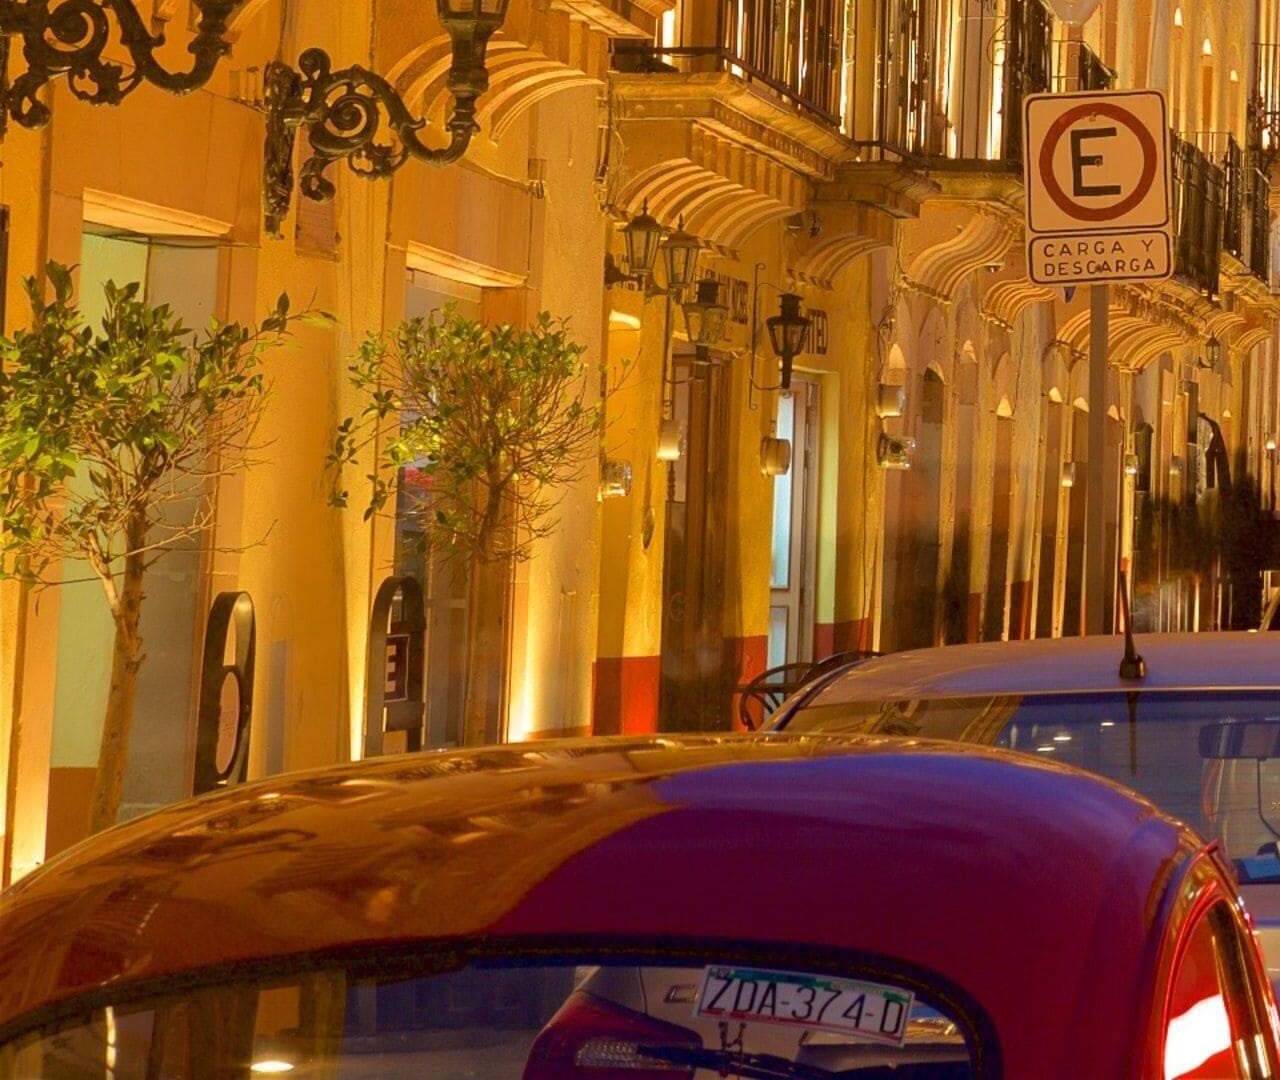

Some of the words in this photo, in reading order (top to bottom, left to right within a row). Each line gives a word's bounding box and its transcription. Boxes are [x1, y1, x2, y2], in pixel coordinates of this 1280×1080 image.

[1070, 127, 1121, 197] E
[1044, 241, 1124, 257] CARGA
[1141, 239, 1154, 251] Y
[1044, 258, 1156, 276] DESCARGA
[706, 977, 904, 1035] ZDA-374-D
